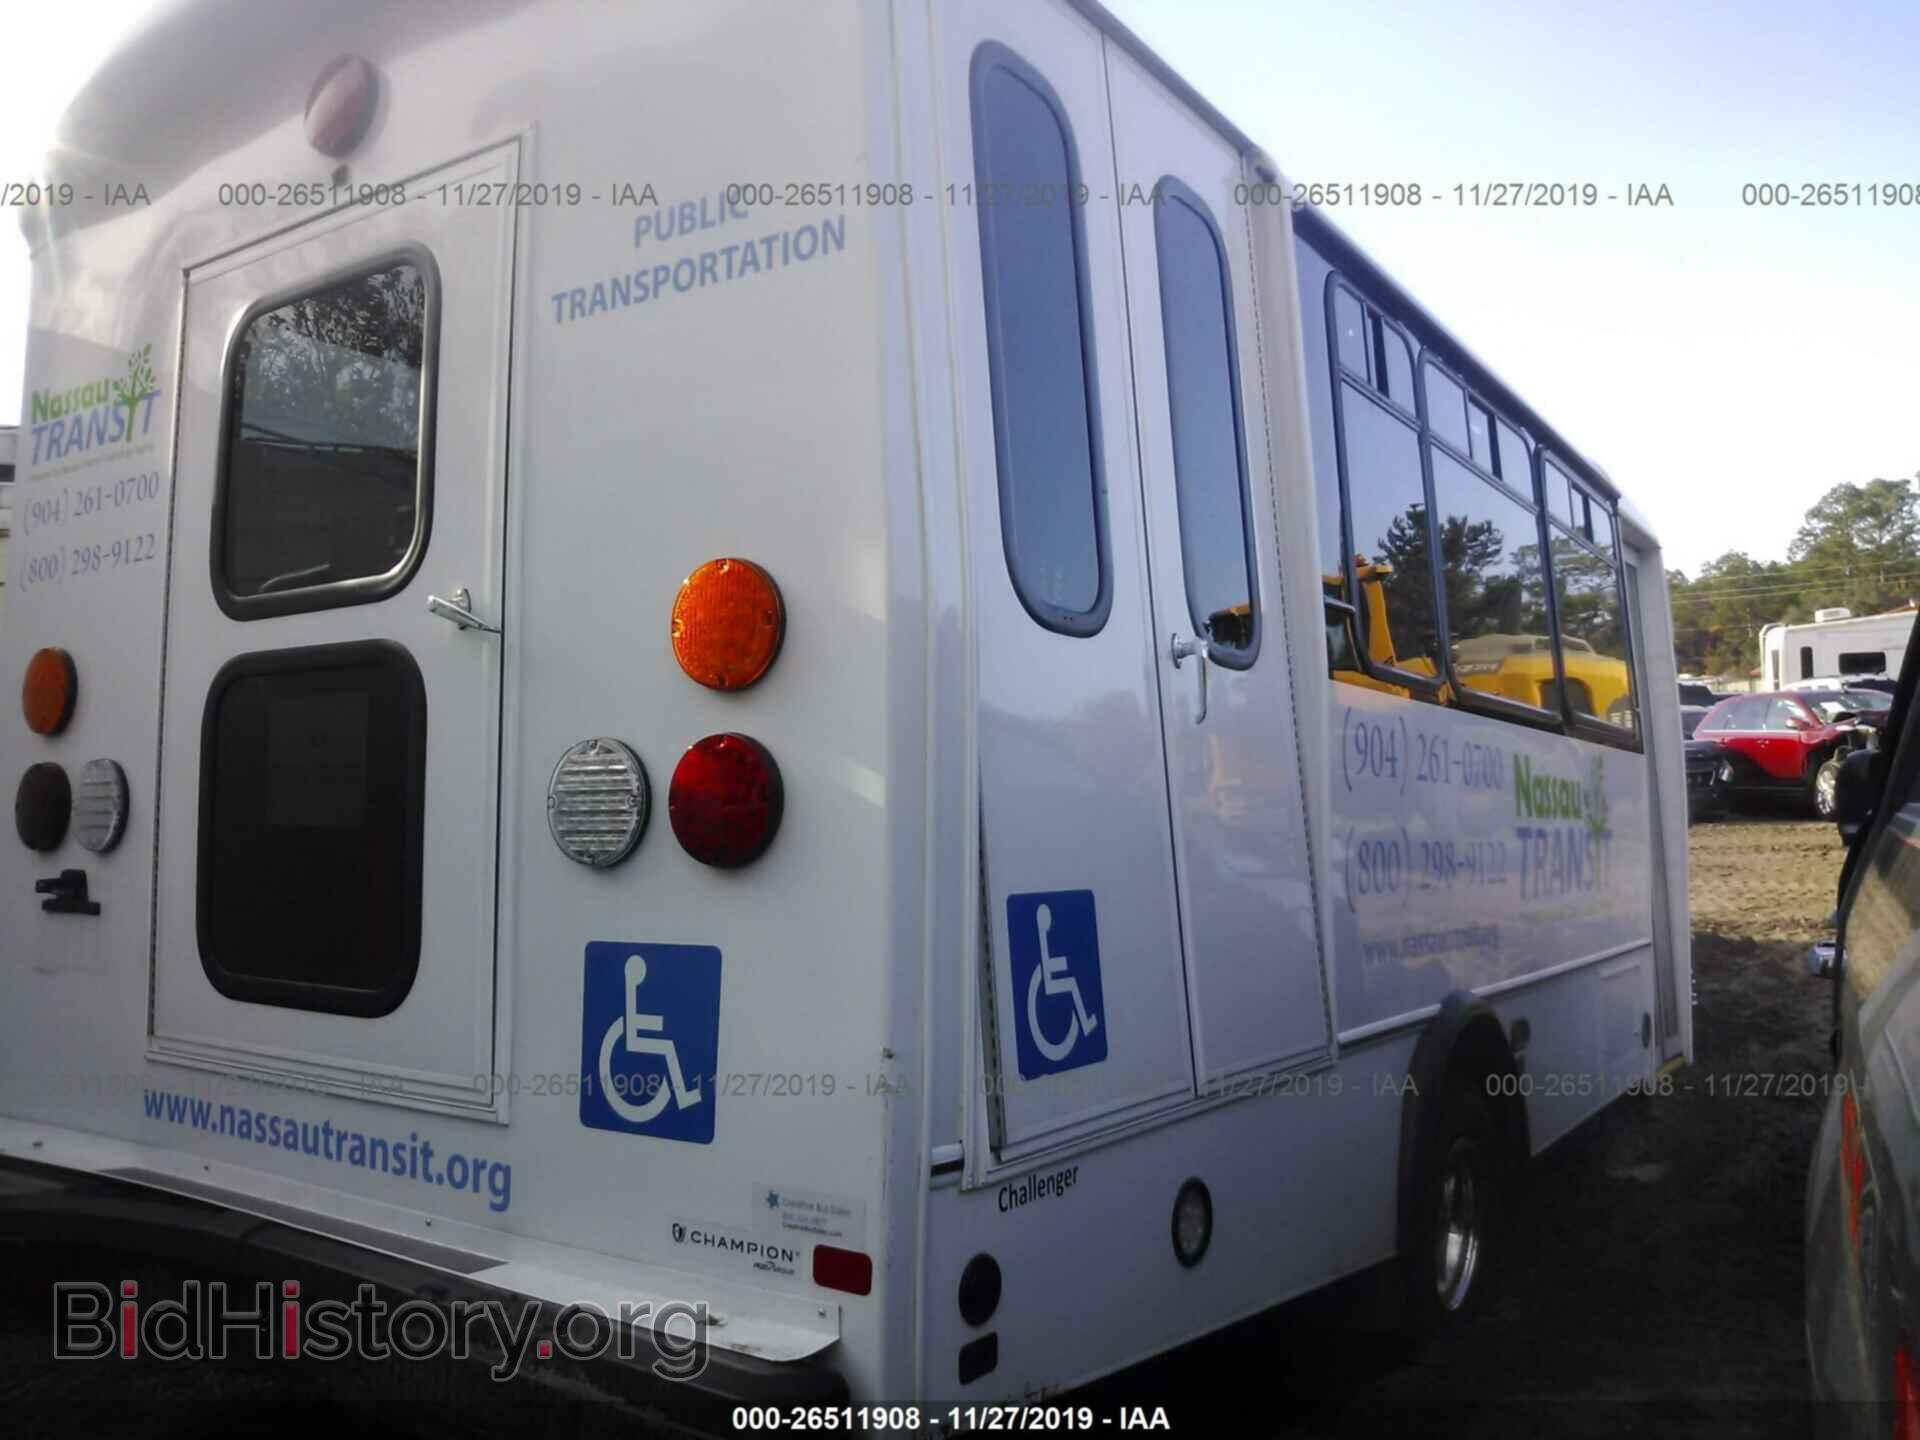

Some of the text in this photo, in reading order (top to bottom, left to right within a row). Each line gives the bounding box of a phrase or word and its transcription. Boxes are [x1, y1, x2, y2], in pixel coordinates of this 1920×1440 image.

[634, 185, 750, 248] PUBLIC
[551, 214, 847, 324] TRANSPORTATION
[31, 378, 110, 424] Nassau
[31, 389, 160, 465] TRANSIT
[23, 471, 159, 536] (904) 261-0700
[19, 533, 155, 592] (800) 298-9122
[1342, 706, 1505, 795] (904) 261-0700
[1513, 753, 1584, 819] Nassau
[1345, 826, 1409, 914] (800)
[1515, 826, 1613, 900] TRANSIT
[143, 1089, 512, 1212] www.nassautransit.org
[997, 1164, 1080, 1214] Challenger
[690, 1230, 794, 1263] CHAMPION
